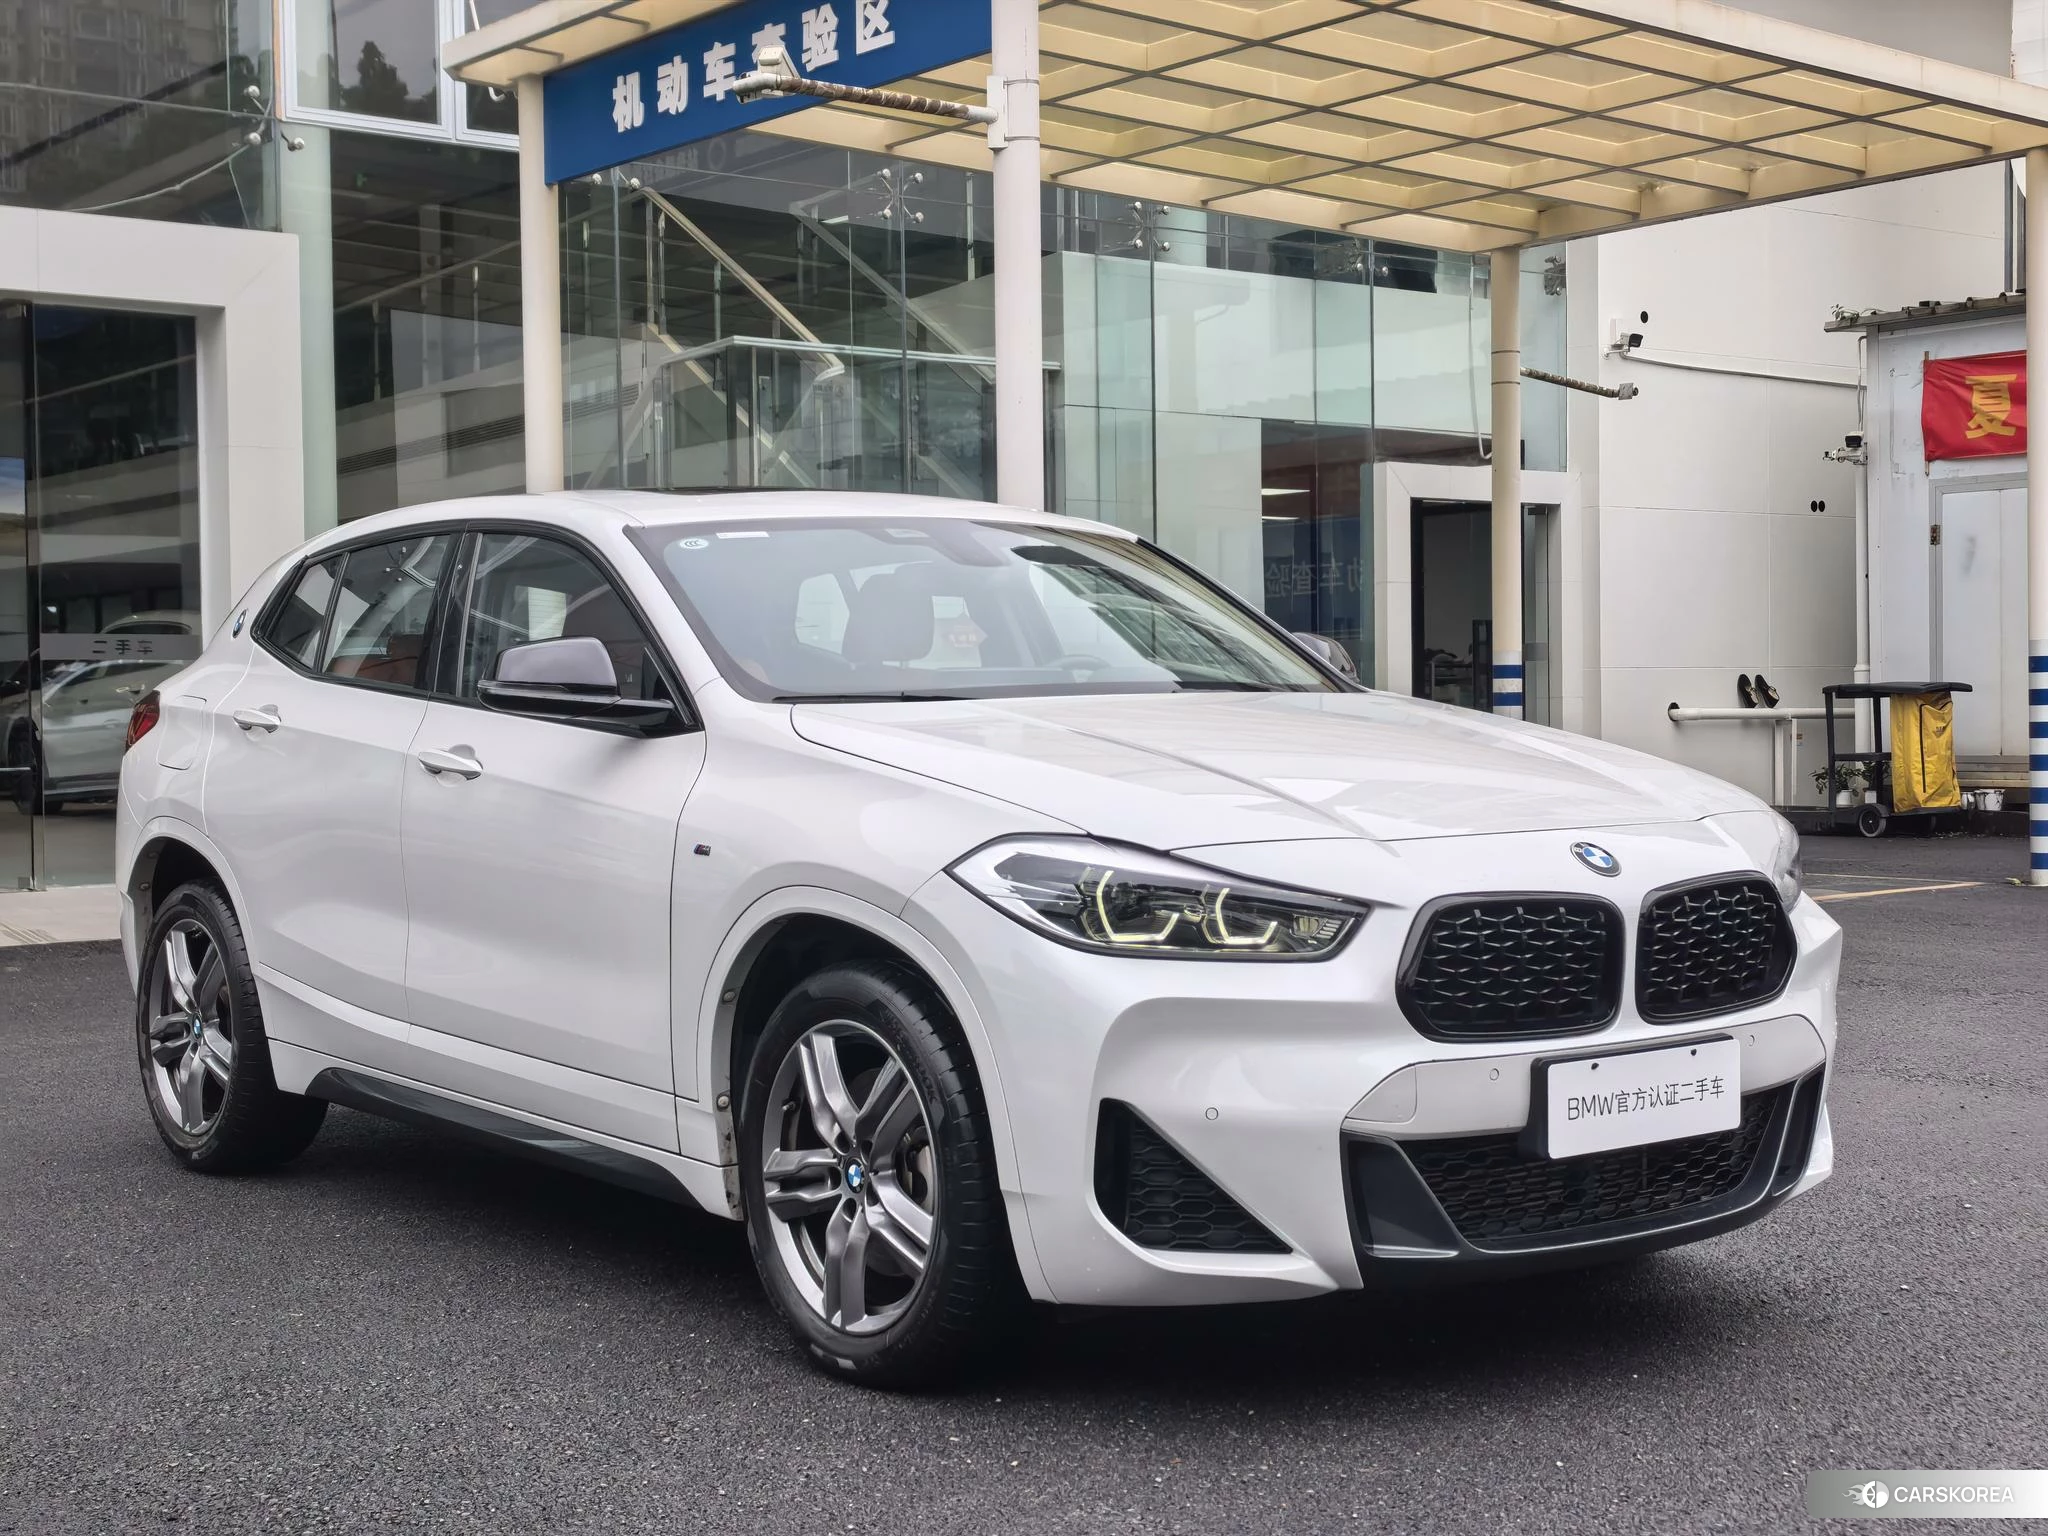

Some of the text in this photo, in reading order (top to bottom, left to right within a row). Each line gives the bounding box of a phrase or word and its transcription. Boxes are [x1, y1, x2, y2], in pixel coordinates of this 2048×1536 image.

[1965, 374, 2018, 439] 夏
[92, 639, 153, 655] 二手车
[1567, 1075, 1725, 1121] BMW官方认证二手车
